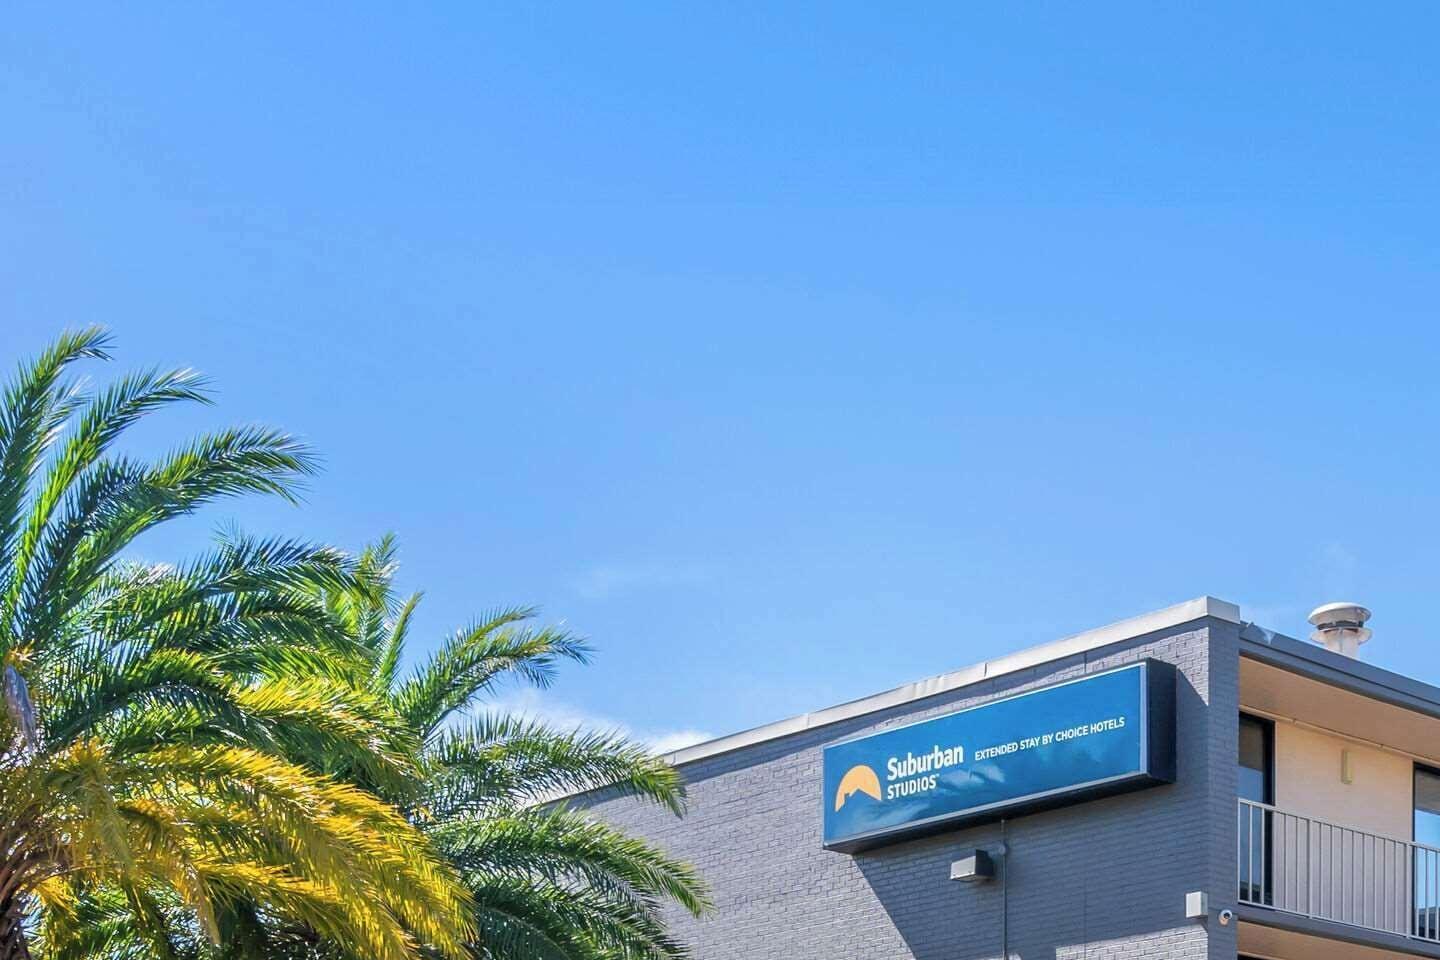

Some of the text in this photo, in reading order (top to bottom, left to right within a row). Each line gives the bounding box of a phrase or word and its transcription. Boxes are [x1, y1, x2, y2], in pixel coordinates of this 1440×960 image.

[975, 716, 1126, 760] EXTENDED STAY BY CHOICE HOTELS
[887, 745, 964, 781] Suburban
[887, 774, 937, 800] STUDIOS
